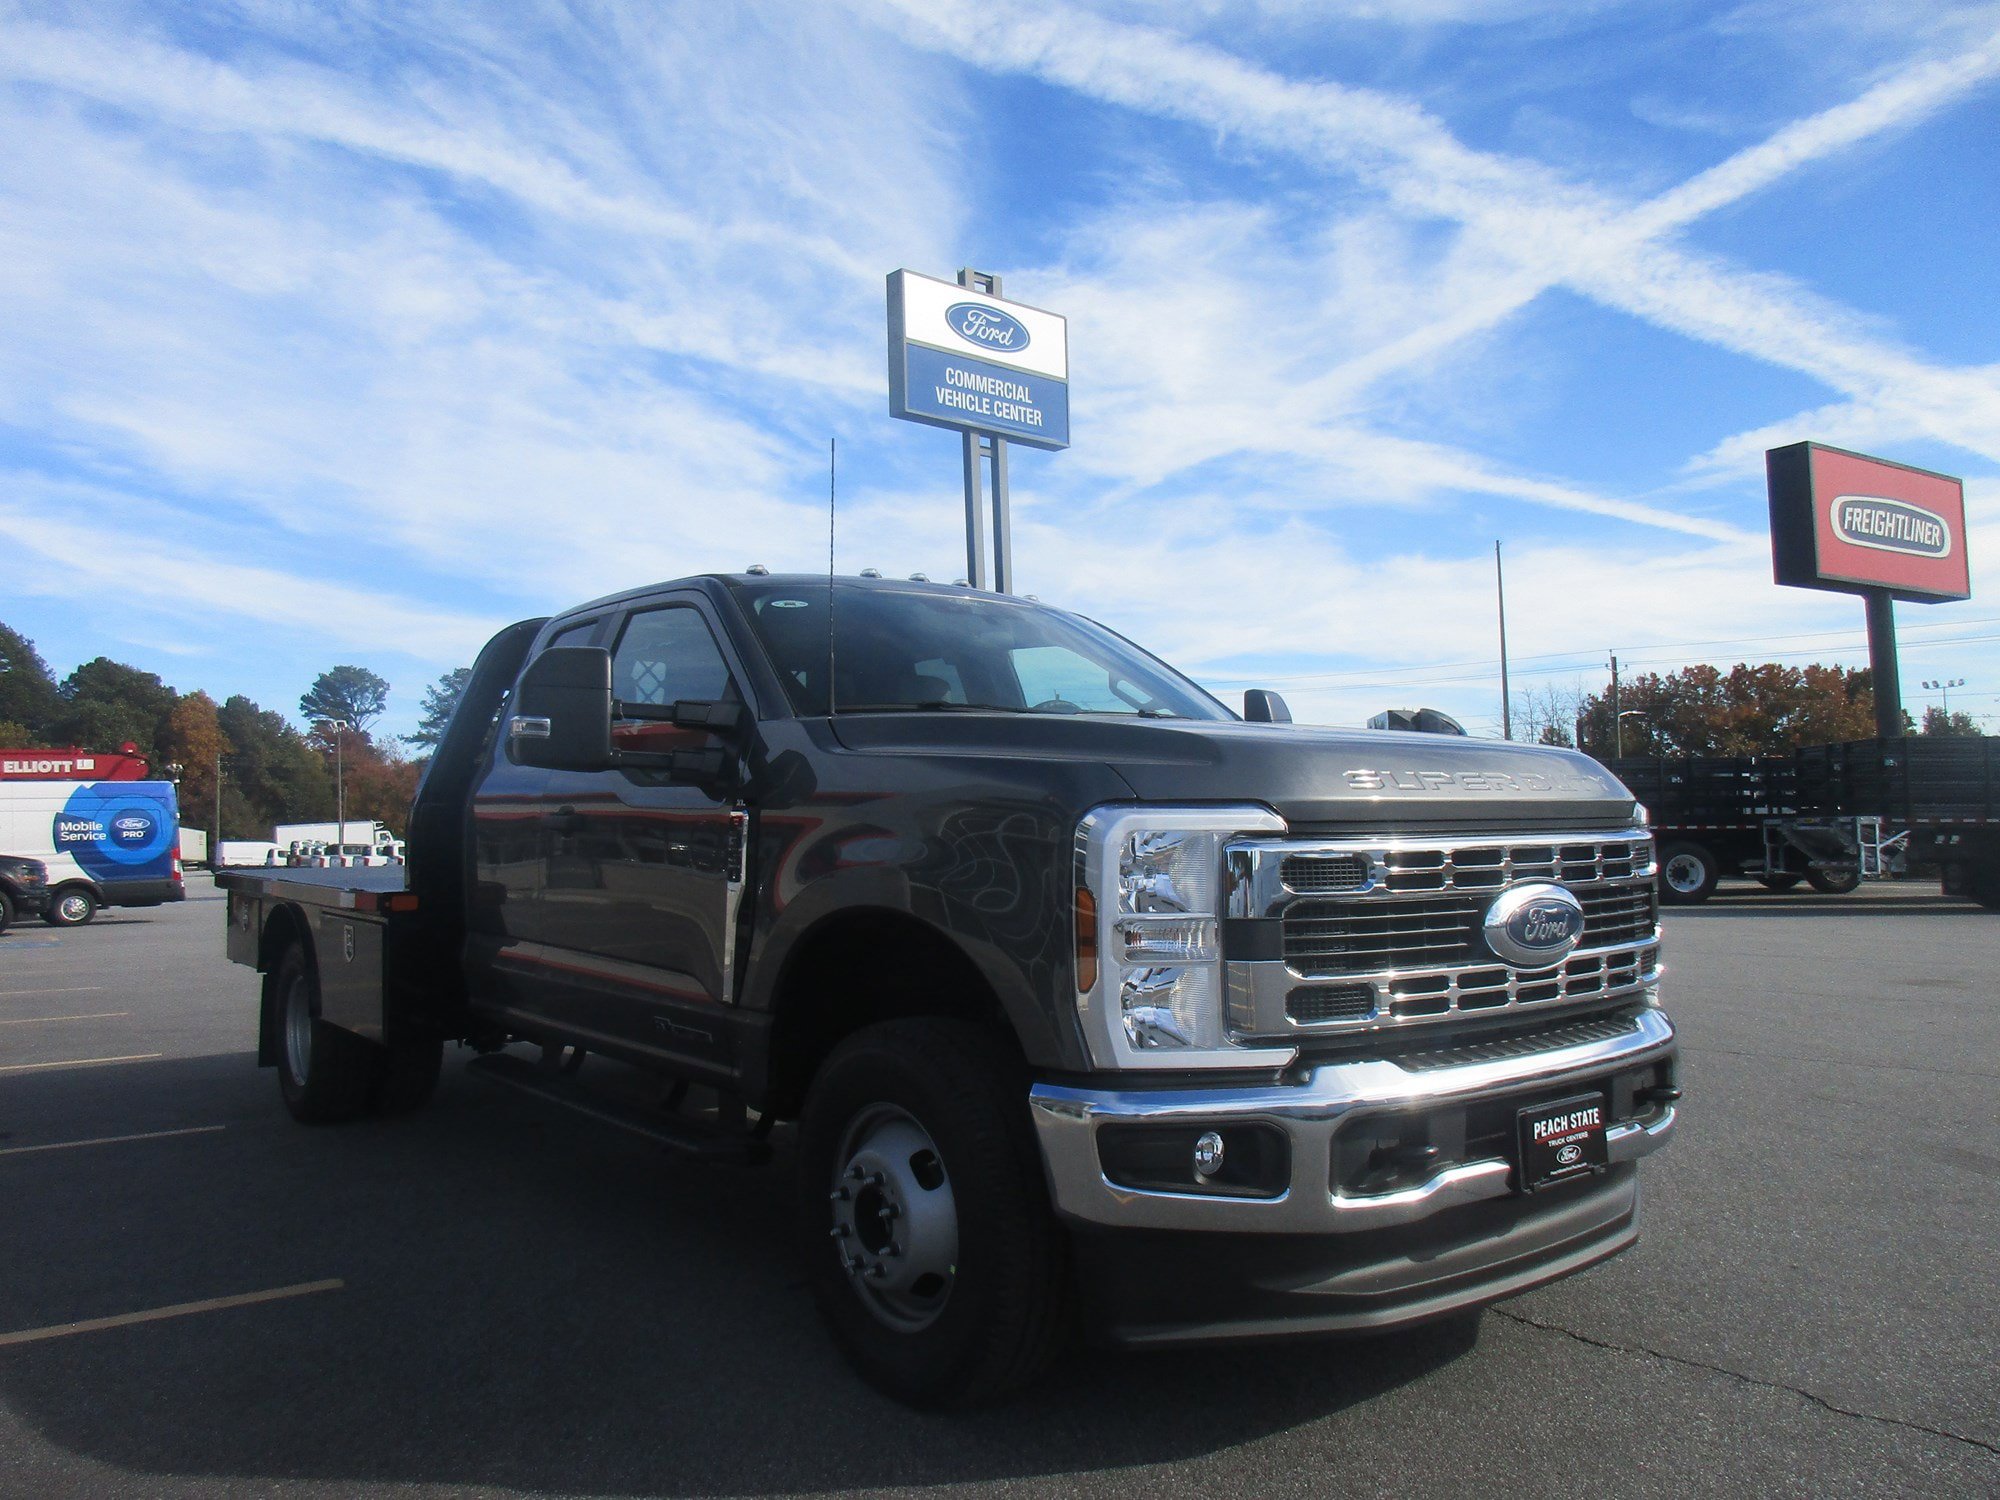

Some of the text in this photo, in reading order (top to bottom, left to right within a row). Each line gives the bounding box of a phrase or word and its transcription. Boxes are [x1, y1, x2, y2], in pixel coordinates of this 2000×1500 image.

[962, 309, 1014, 346] Ford
[945, 366, 1033, 404] COMMERCIAL
[935, 386, 1043, 427] VEHICLE CENTER
[1843, 506, 1942, 547] FREIGHTLINER
[3, 760, 73, 774] ELLIOTT
[60, 821, 103, 832] Mobile
[60, 831, 107, 841] Service
[1524, 907, 1570, 941] Ford
[1533, 1107, 1600, 1140] PEACH STATE
[1548, 1131, 1588, 1147] TRUCK CENTERS
[1561, 1148, 1577, 1161] Ford
